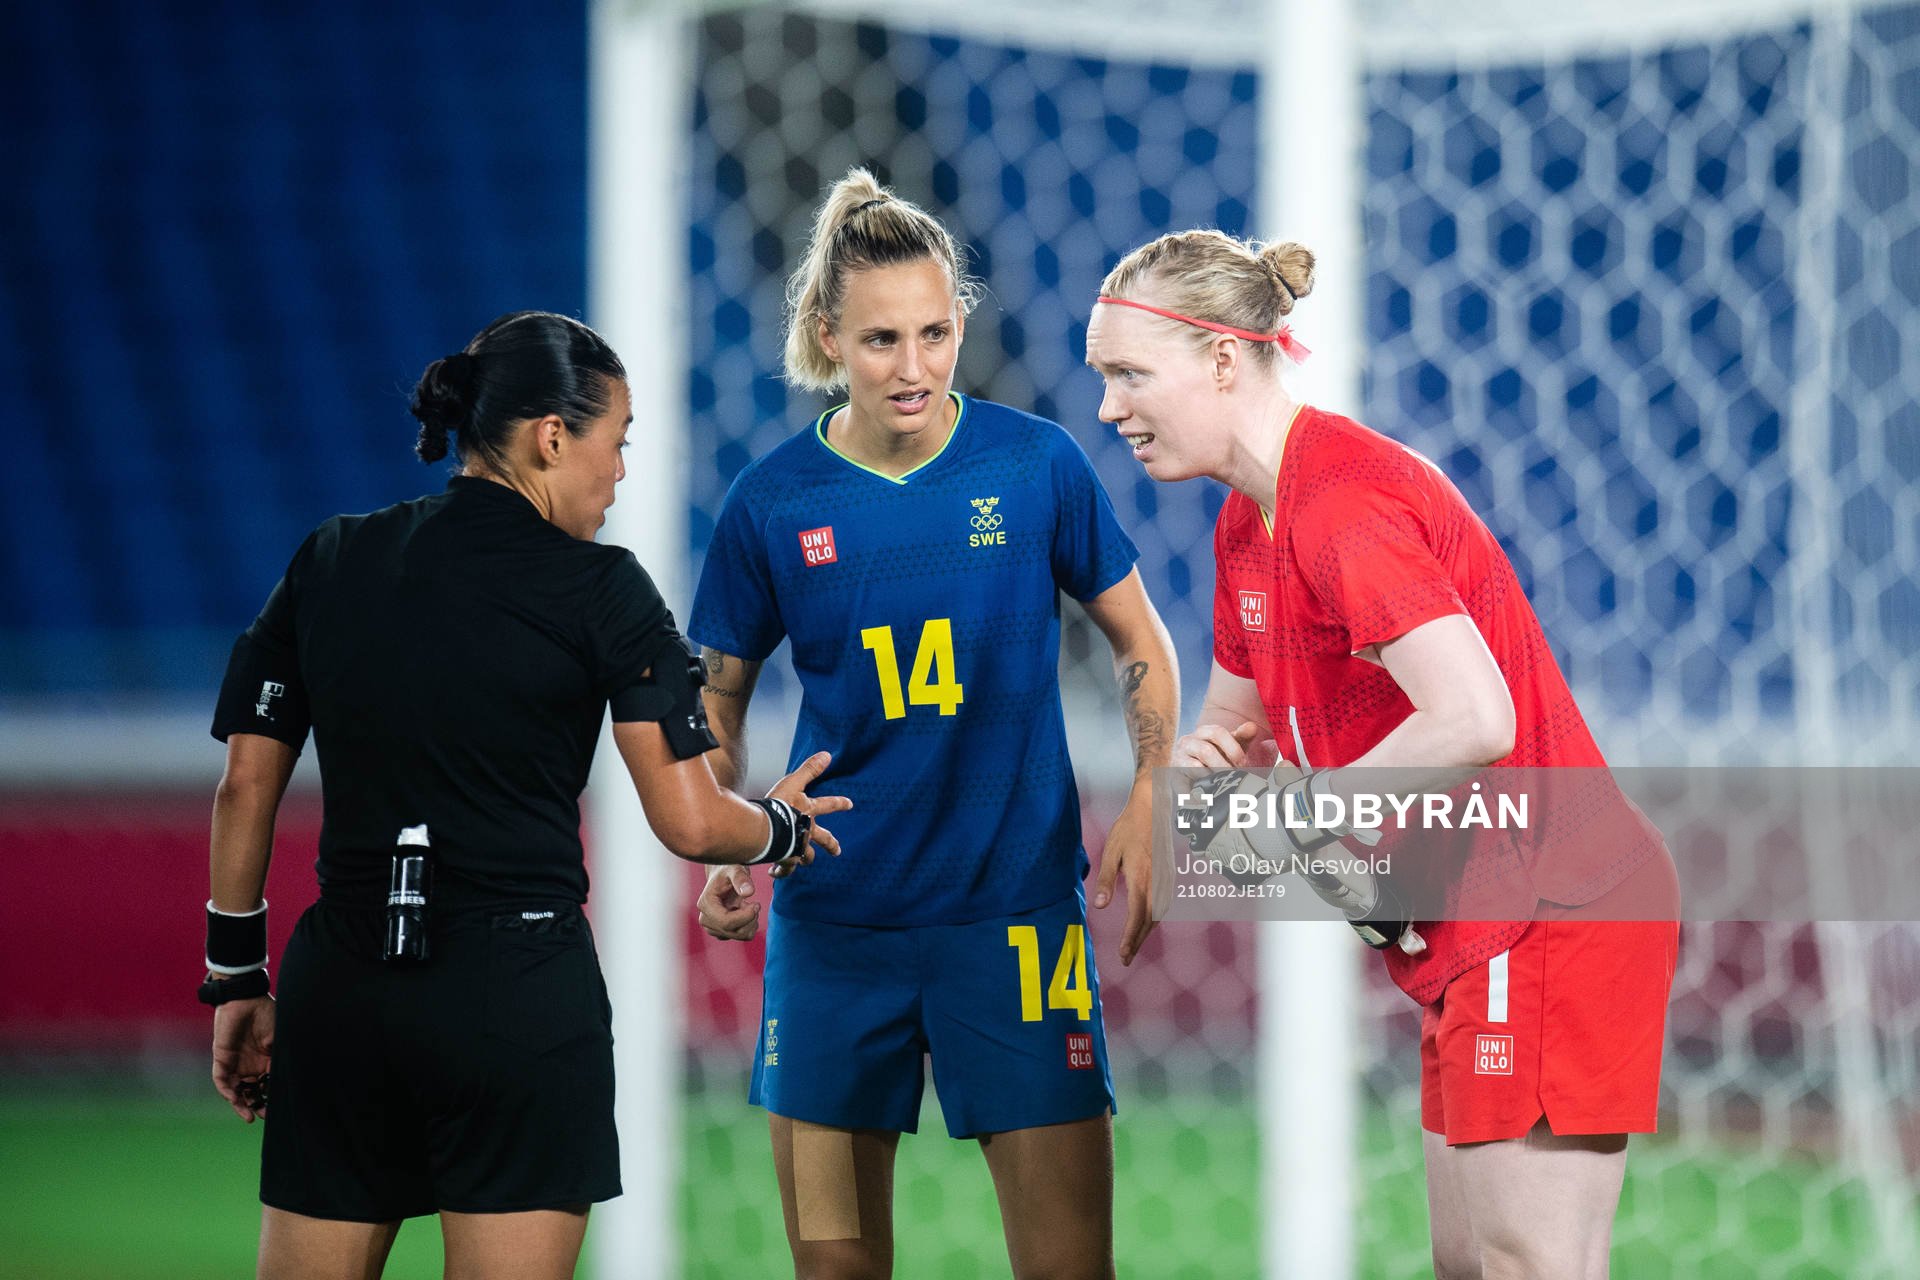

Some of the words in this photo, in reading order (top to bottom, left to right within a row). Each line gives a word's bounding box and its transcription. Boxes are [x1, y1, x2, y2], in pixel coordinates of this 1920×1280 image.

[803, 532, 828, 548] UNI
[969, 531, 1006, 548] SWE
[806, 546, 833, 564] QLO
[1242, 596, 1261, 611] UNI
[1242, 611, 1262, 627] QLO
[861, 618, 964, 720] 14
[1008, 925, 1093, 1022] 14
[1069, 1038, 1089, 1050] UNI
[1480, 1040, 1506, 1054] UNI
[1070, 1052, 1092, 1067] QLO
[1480, 1055, 1508, 1071] QLO
